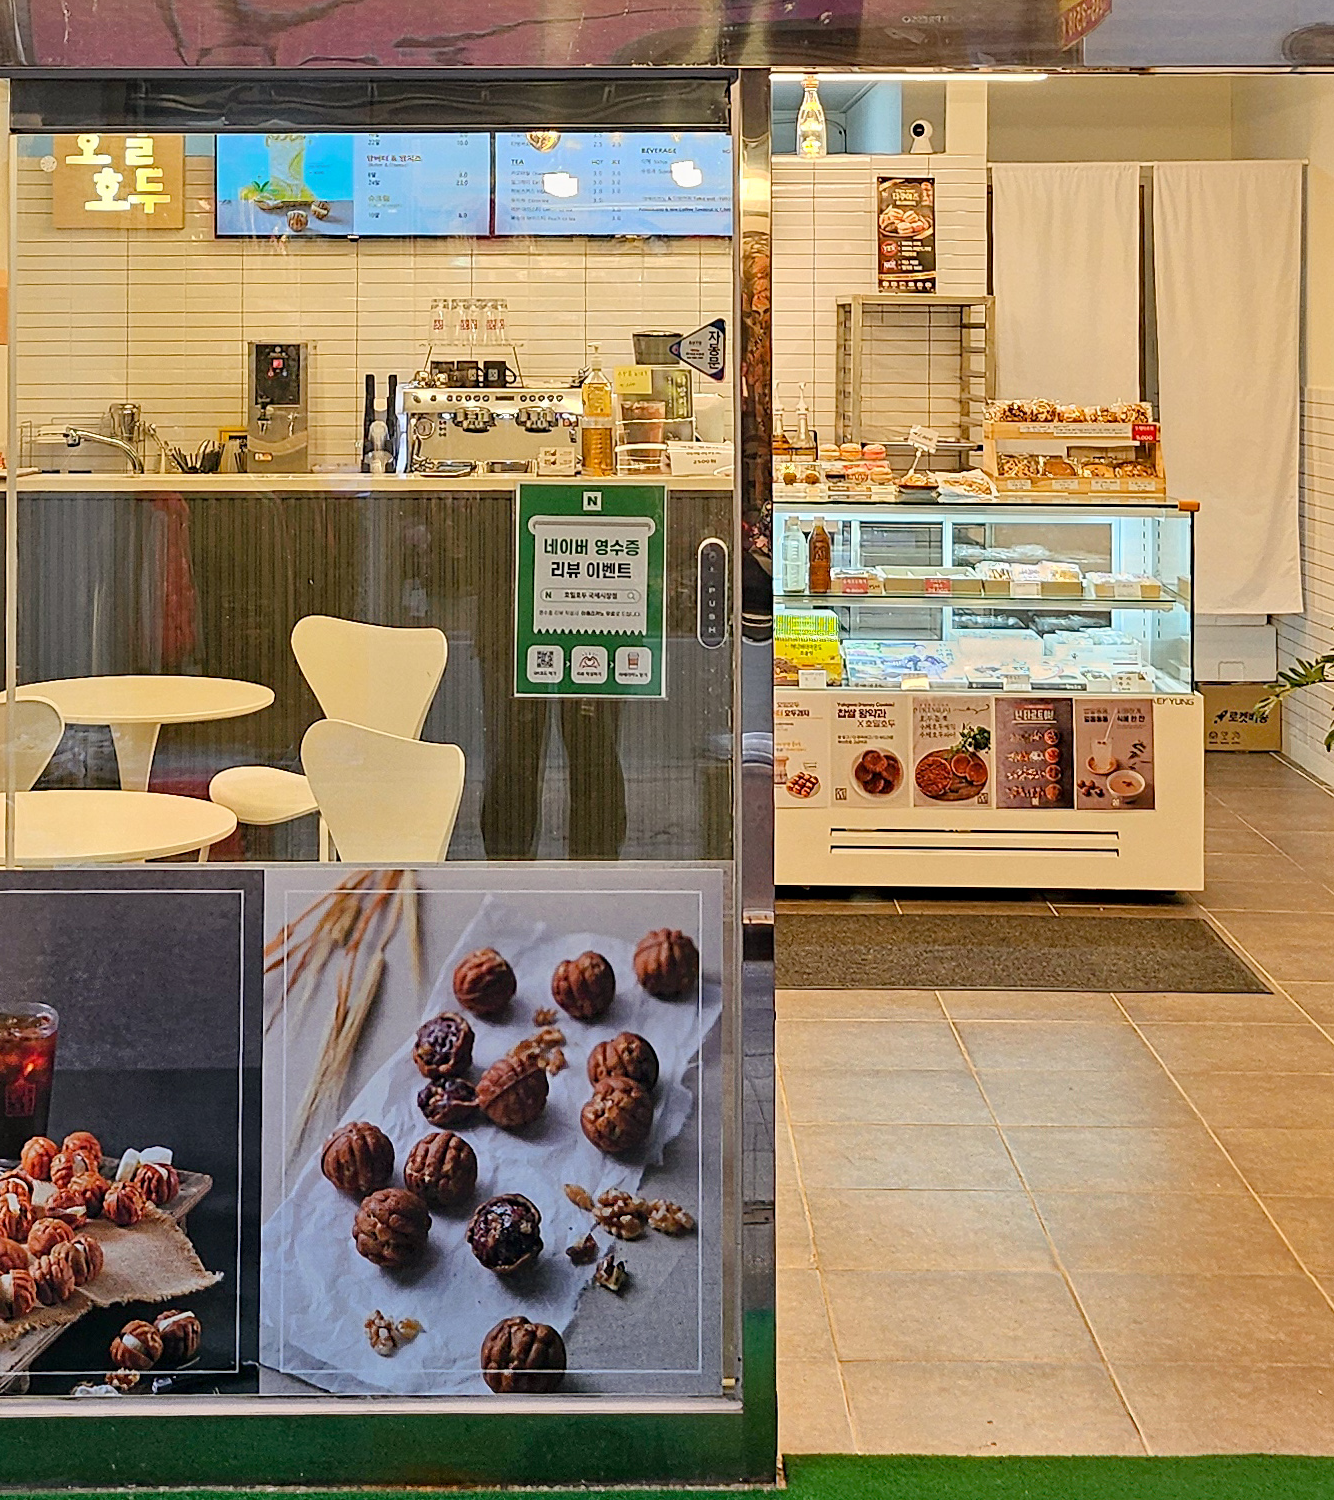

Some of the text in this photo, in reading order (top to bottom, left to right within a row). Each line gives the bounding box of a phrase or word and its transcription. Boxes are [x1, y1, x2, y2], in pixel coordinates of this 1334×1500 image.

[85, 167, 170, 213] 호두
[708, 330, 720, 369] 자동문
[587, 496, 598, 506] N
[544, 538, 640, 556] 네이버 영수증
[551, 562, 632, 579] 리뷰 이벤트
[708, 587, 716, 634] PUSH
